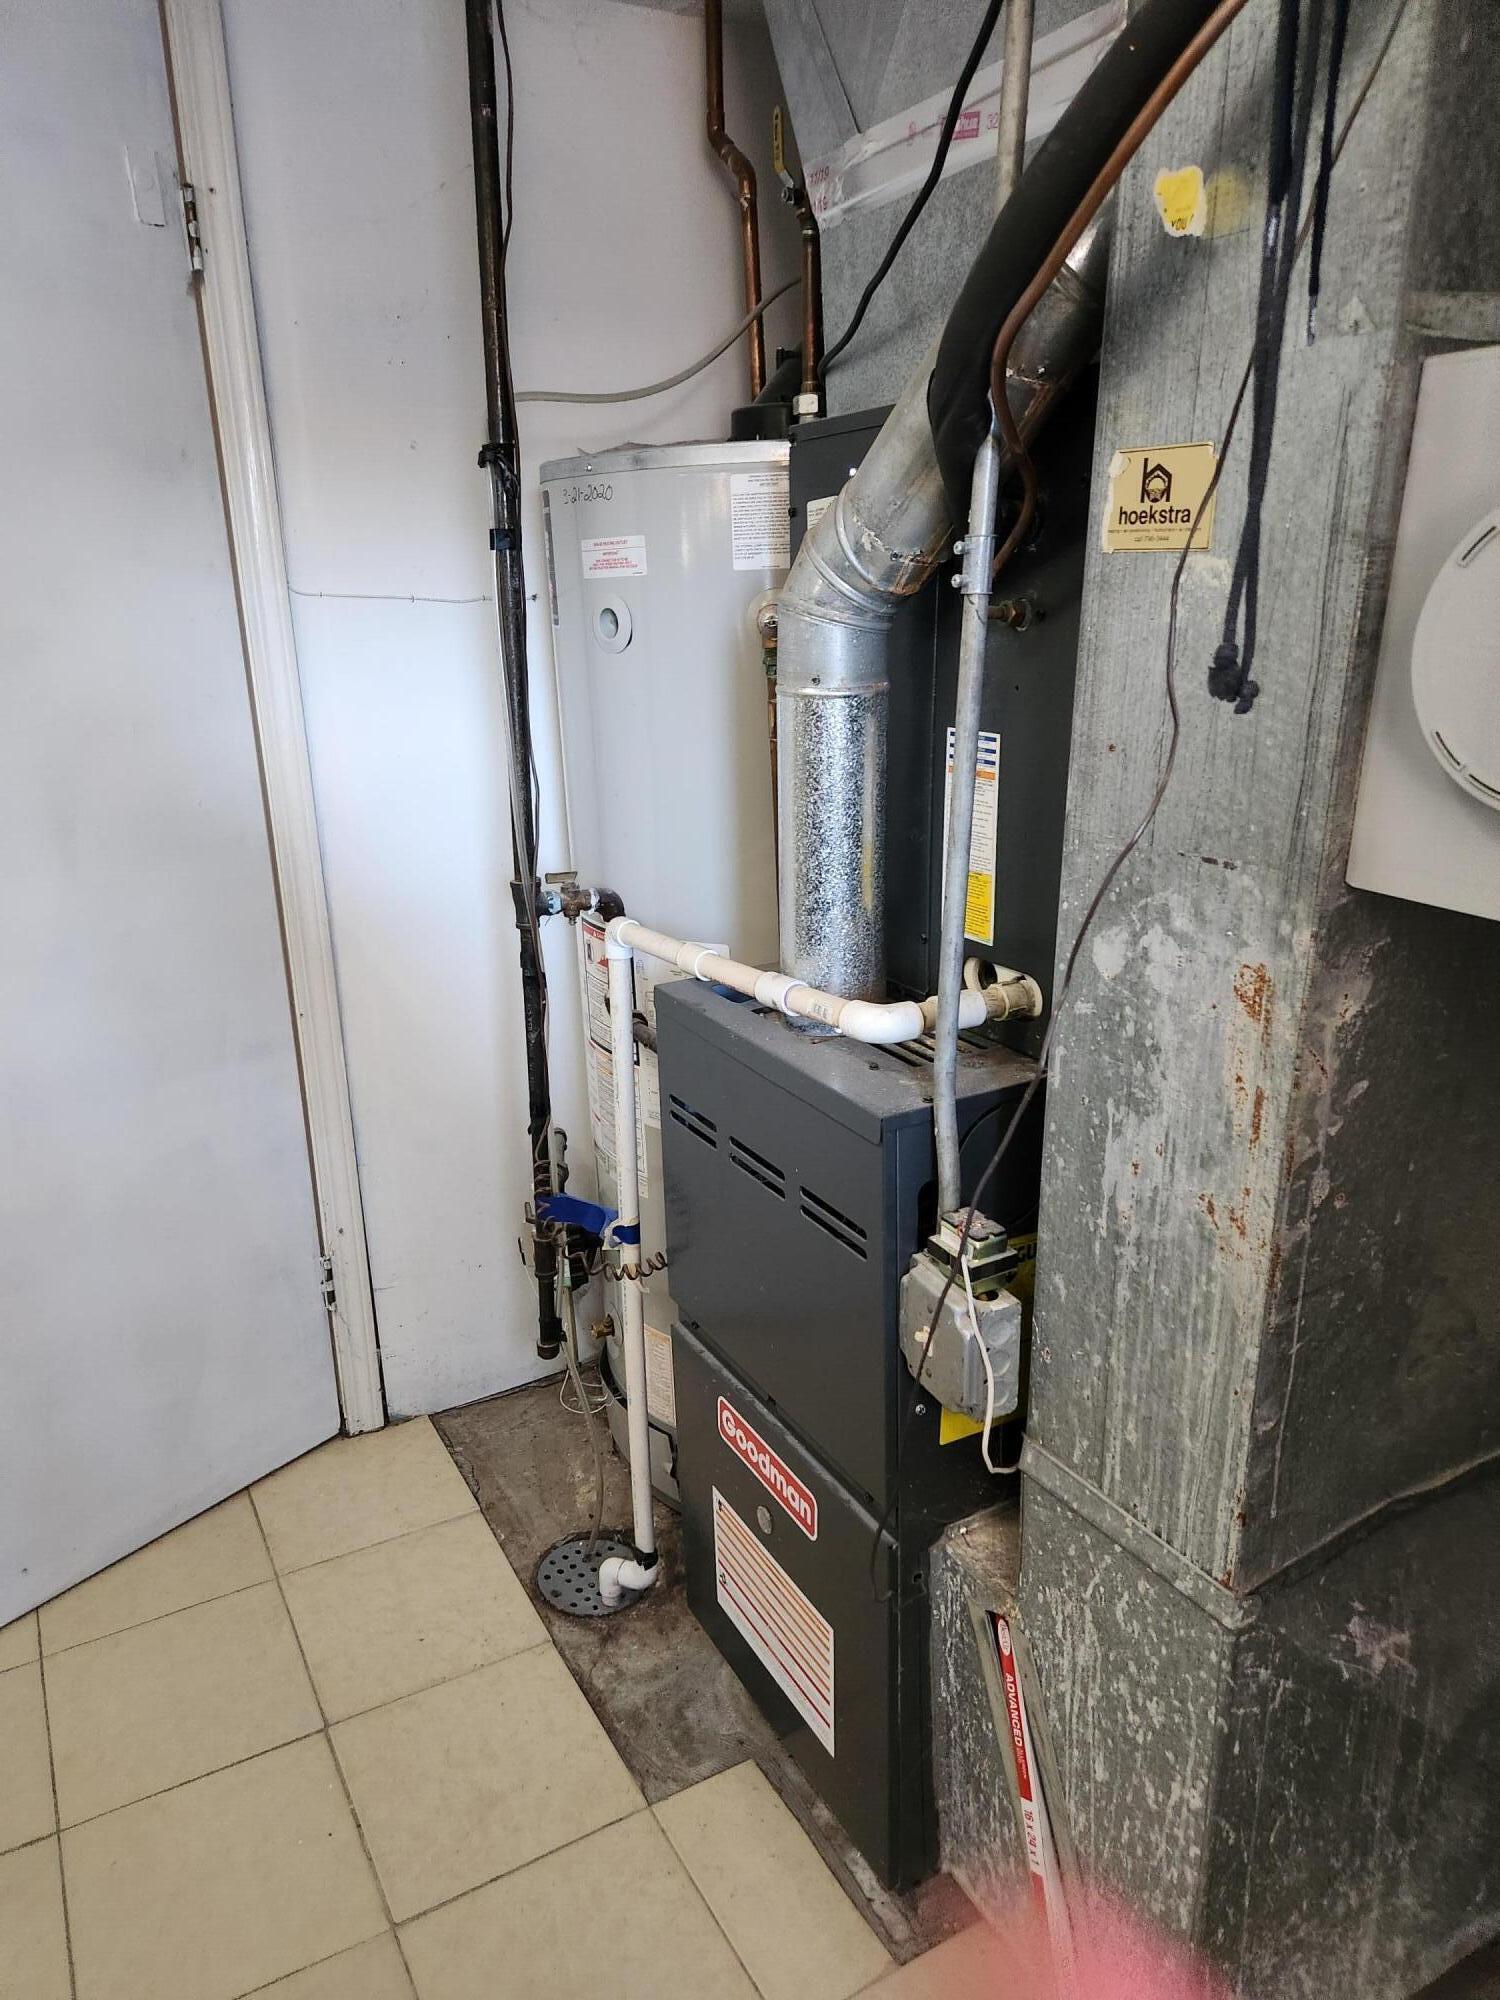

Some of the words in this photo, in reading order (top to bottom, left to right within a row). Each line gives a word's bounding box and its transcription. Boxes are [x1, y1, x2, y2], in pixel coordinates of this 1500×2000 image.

[562, 484, 613, 505] 3-21-2020
[1119, 505, 1191, 525] hoekstra
[722, 1409, 812, 1526] Goodman
[1005, 1672, 1023, 1747] ADVANCED
[1024, 1810, 1034, 1822] 16
